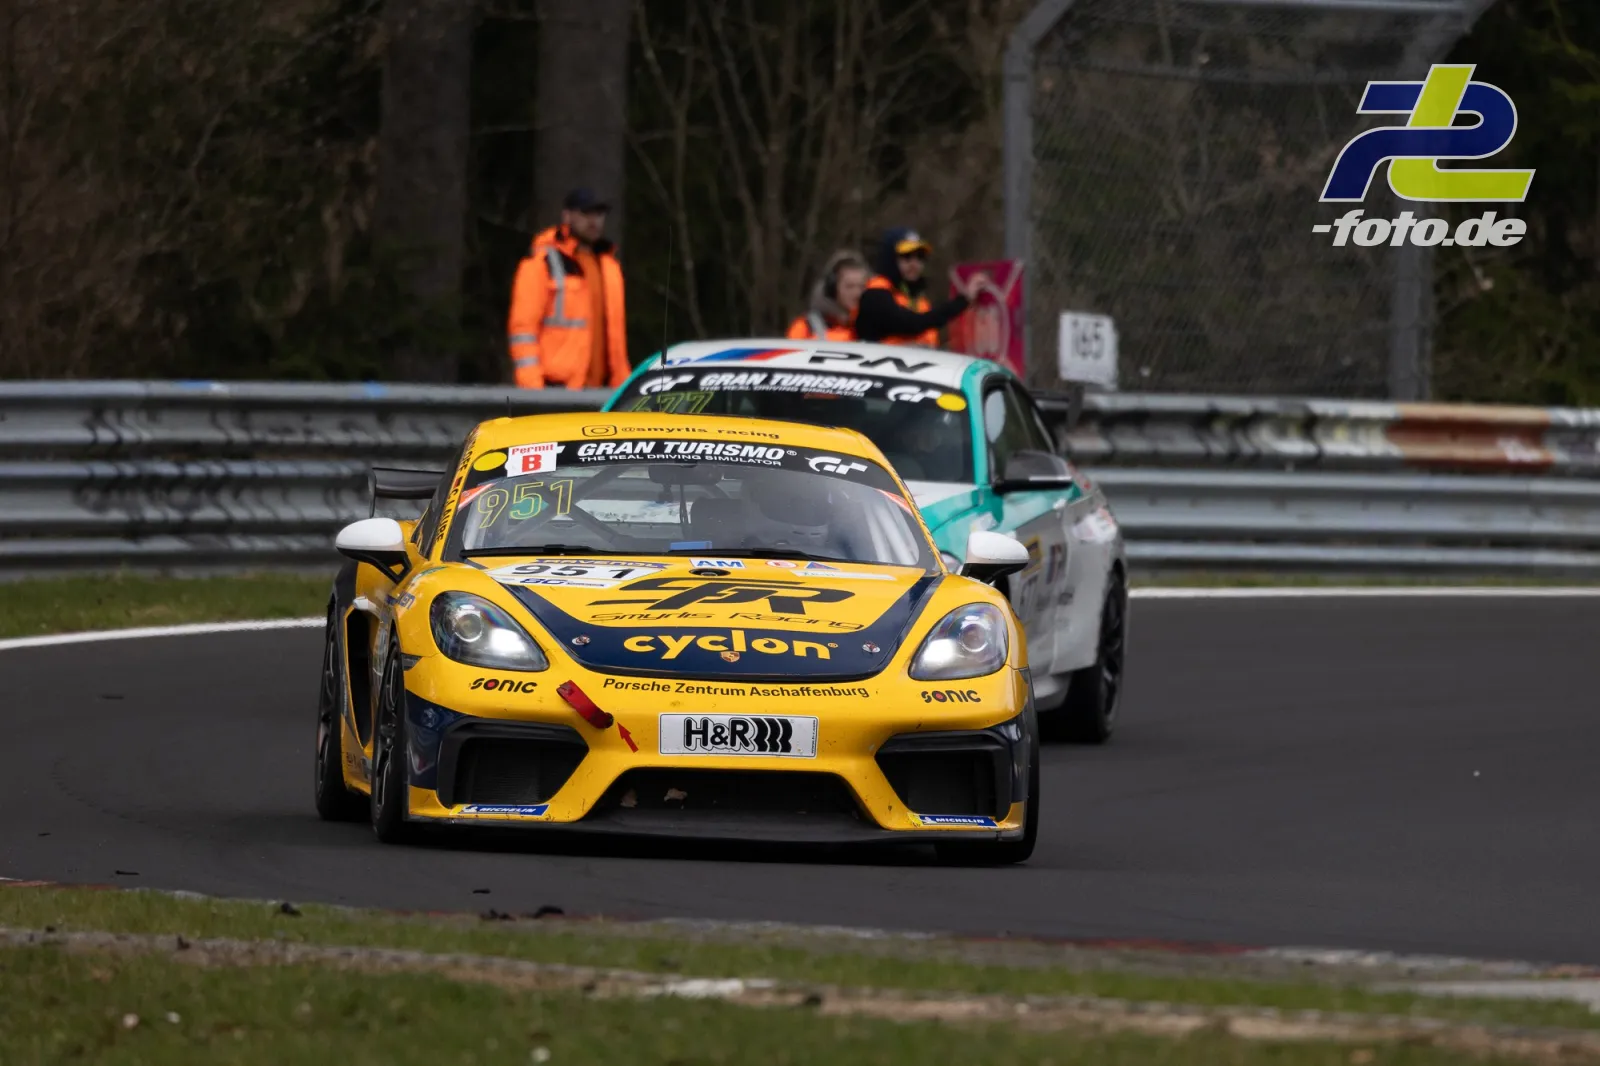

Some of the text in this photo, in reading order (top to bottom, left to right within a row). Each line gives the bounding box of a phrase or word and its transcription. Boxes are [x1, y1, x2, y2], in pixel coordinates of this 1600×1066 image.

[700, 372, 769, 386] GRAN
[511, 444, 554, 455] Permit
[577, 441, 656, 456] GRAN
[521, 454, 542, 473] B
[578, 455, 604, 463] THE
[704, 455, 782, 467] SIMULATOR
[477, 479, 573, 529] 951
[512, 564, 635, 580] 951
[588, 611, 865, 631] Smyrlis Racing
[602, 677, 869, 699] Porsche Zentrum Aschaffenburg
[684, 717, 755, 752] H&R
